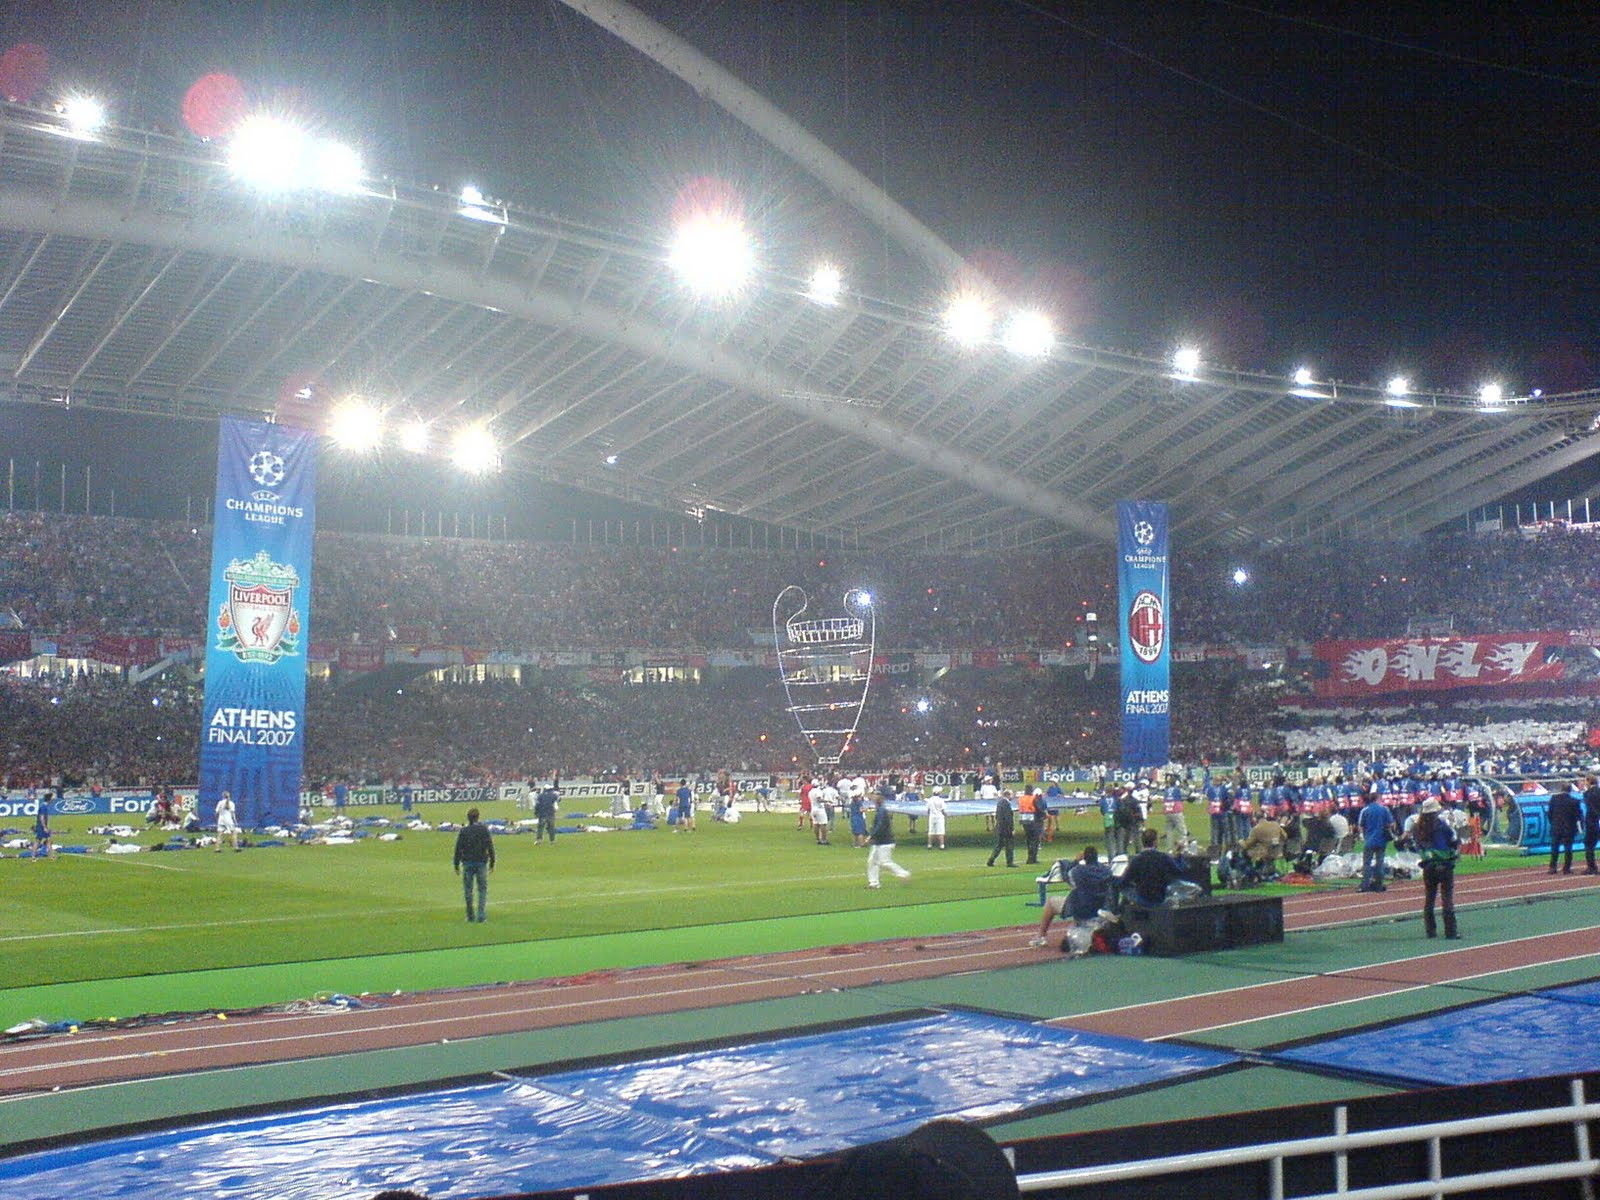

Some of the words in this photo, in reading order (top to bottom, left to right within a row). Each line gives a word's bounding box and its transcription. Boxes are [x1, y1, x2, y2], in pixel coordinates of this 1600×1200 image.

[226, 498, 303, 518] CHAMPIONS
[245, 512, 285, 525] LEAGUE
[1124, 554, 1166, 563] CHAMPIONS
[234, 590, 288, 605] LIVERPOOL
[1340, 641, 1540, 686] ONLY
[1126, 690, 1169, 704] ATHENS
[1125, 703, 1151, 714] FINAL
[1151, 702, 1168, 714] 2007
[210, 707, 296, 729] ATHENS
[208, 728, 256, 744] FINAL
[257, 730, 295, 746] 2007
[1043, 771, 1075, 782] Ford
[1113, 770, 1136, 781] For
[401, 789, 452, 803] THENS
[453, 788, 484, 801] 2007
[633, 784, 645, 794] 3
[110, 797, 157, 812] For
[299, 790, 378, 807] Heken
